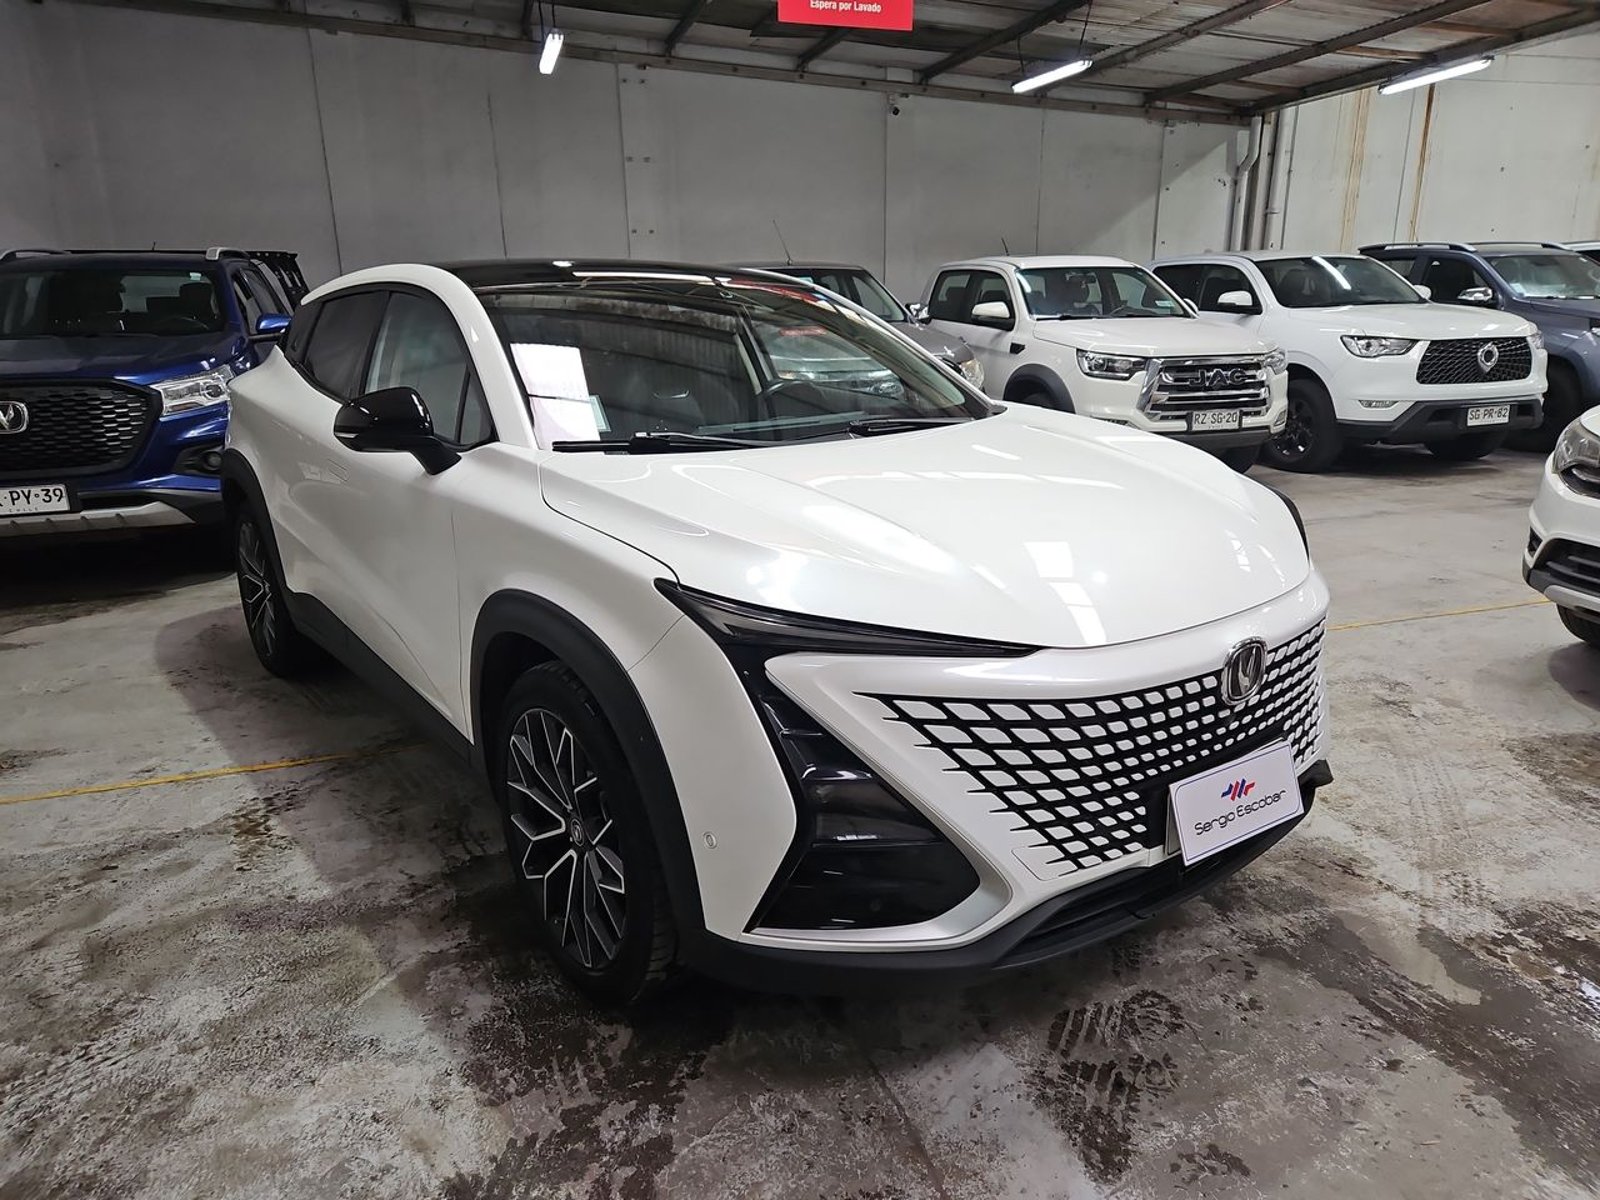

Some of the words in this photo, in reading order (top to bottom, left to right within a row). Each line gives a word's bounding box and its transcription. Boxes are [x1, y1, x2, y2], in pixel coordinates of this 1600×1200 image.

[810, 0, 837, 10] Espera
[839, 2, 852, 12] por
[853, 1, 882, 13] Lavado
[1188, 368, 1248, 389] JAC
[1194, 812, 1236, 835] Sergio
[1236, 789, 1286, 817] Escobar
